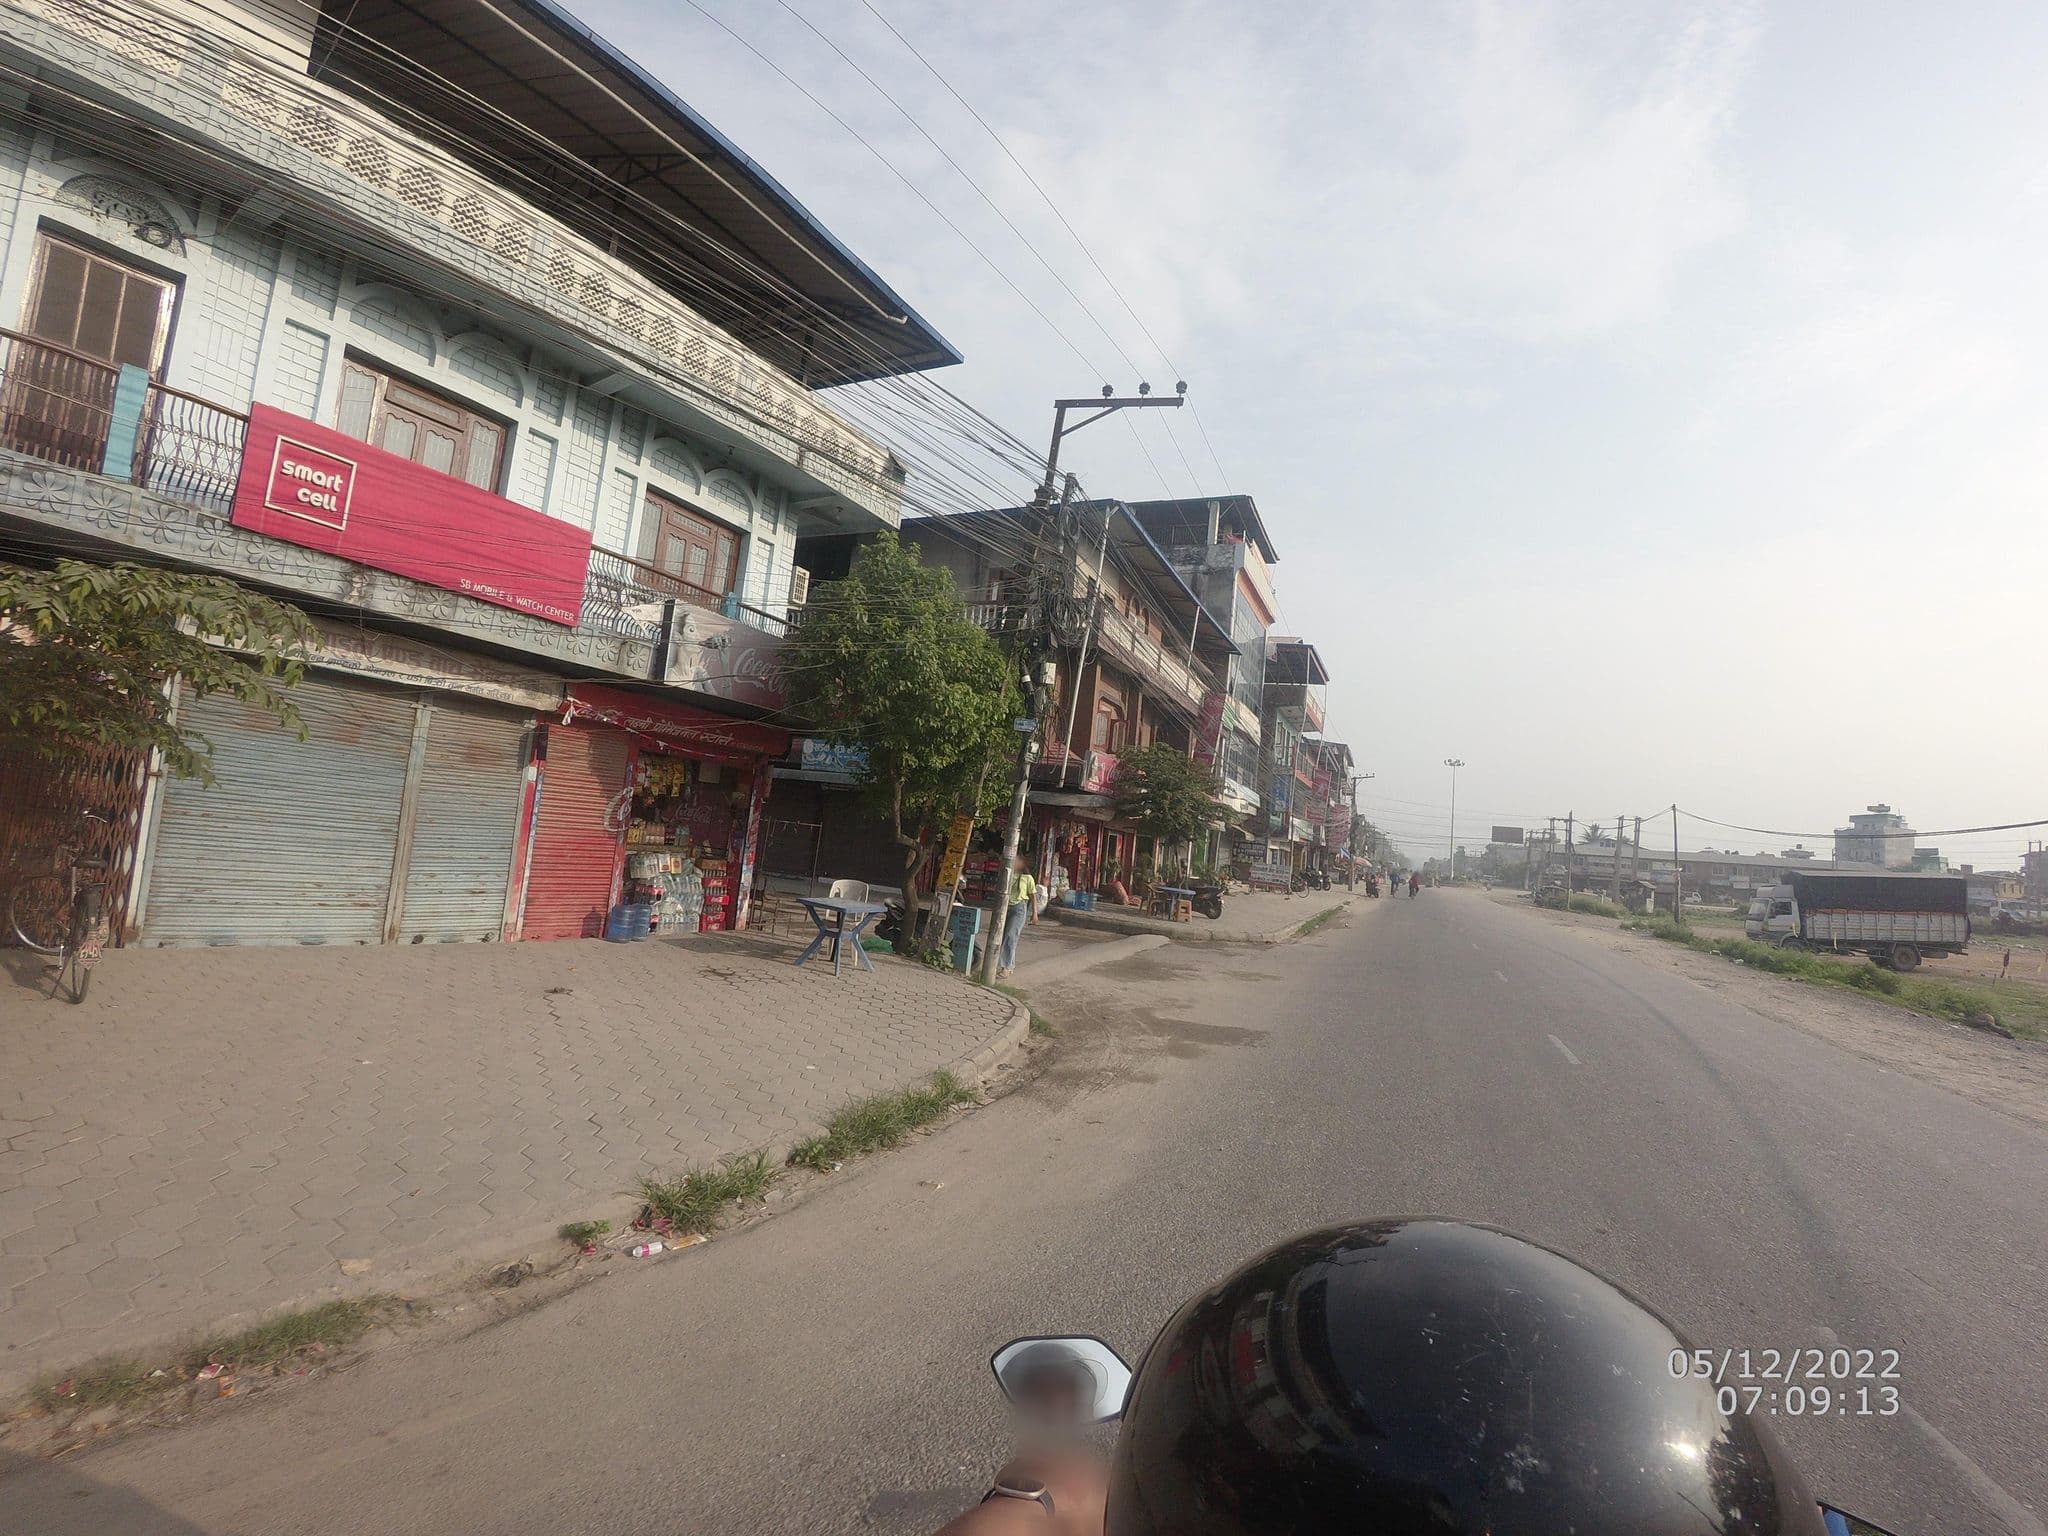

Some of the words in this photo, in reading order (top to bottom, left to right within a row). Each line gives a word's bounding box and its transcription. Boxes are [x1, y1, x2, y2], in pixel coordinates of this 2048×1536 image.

[282, 459, 344, 493] smart
[297, 487, 338, 512] cell
[460, 578, 471, 590] SB
[473, 583, 505, 600] MOBILE
[516, 595, 543, 612] WATCH
[545, 605, 575, 621] CENTER
